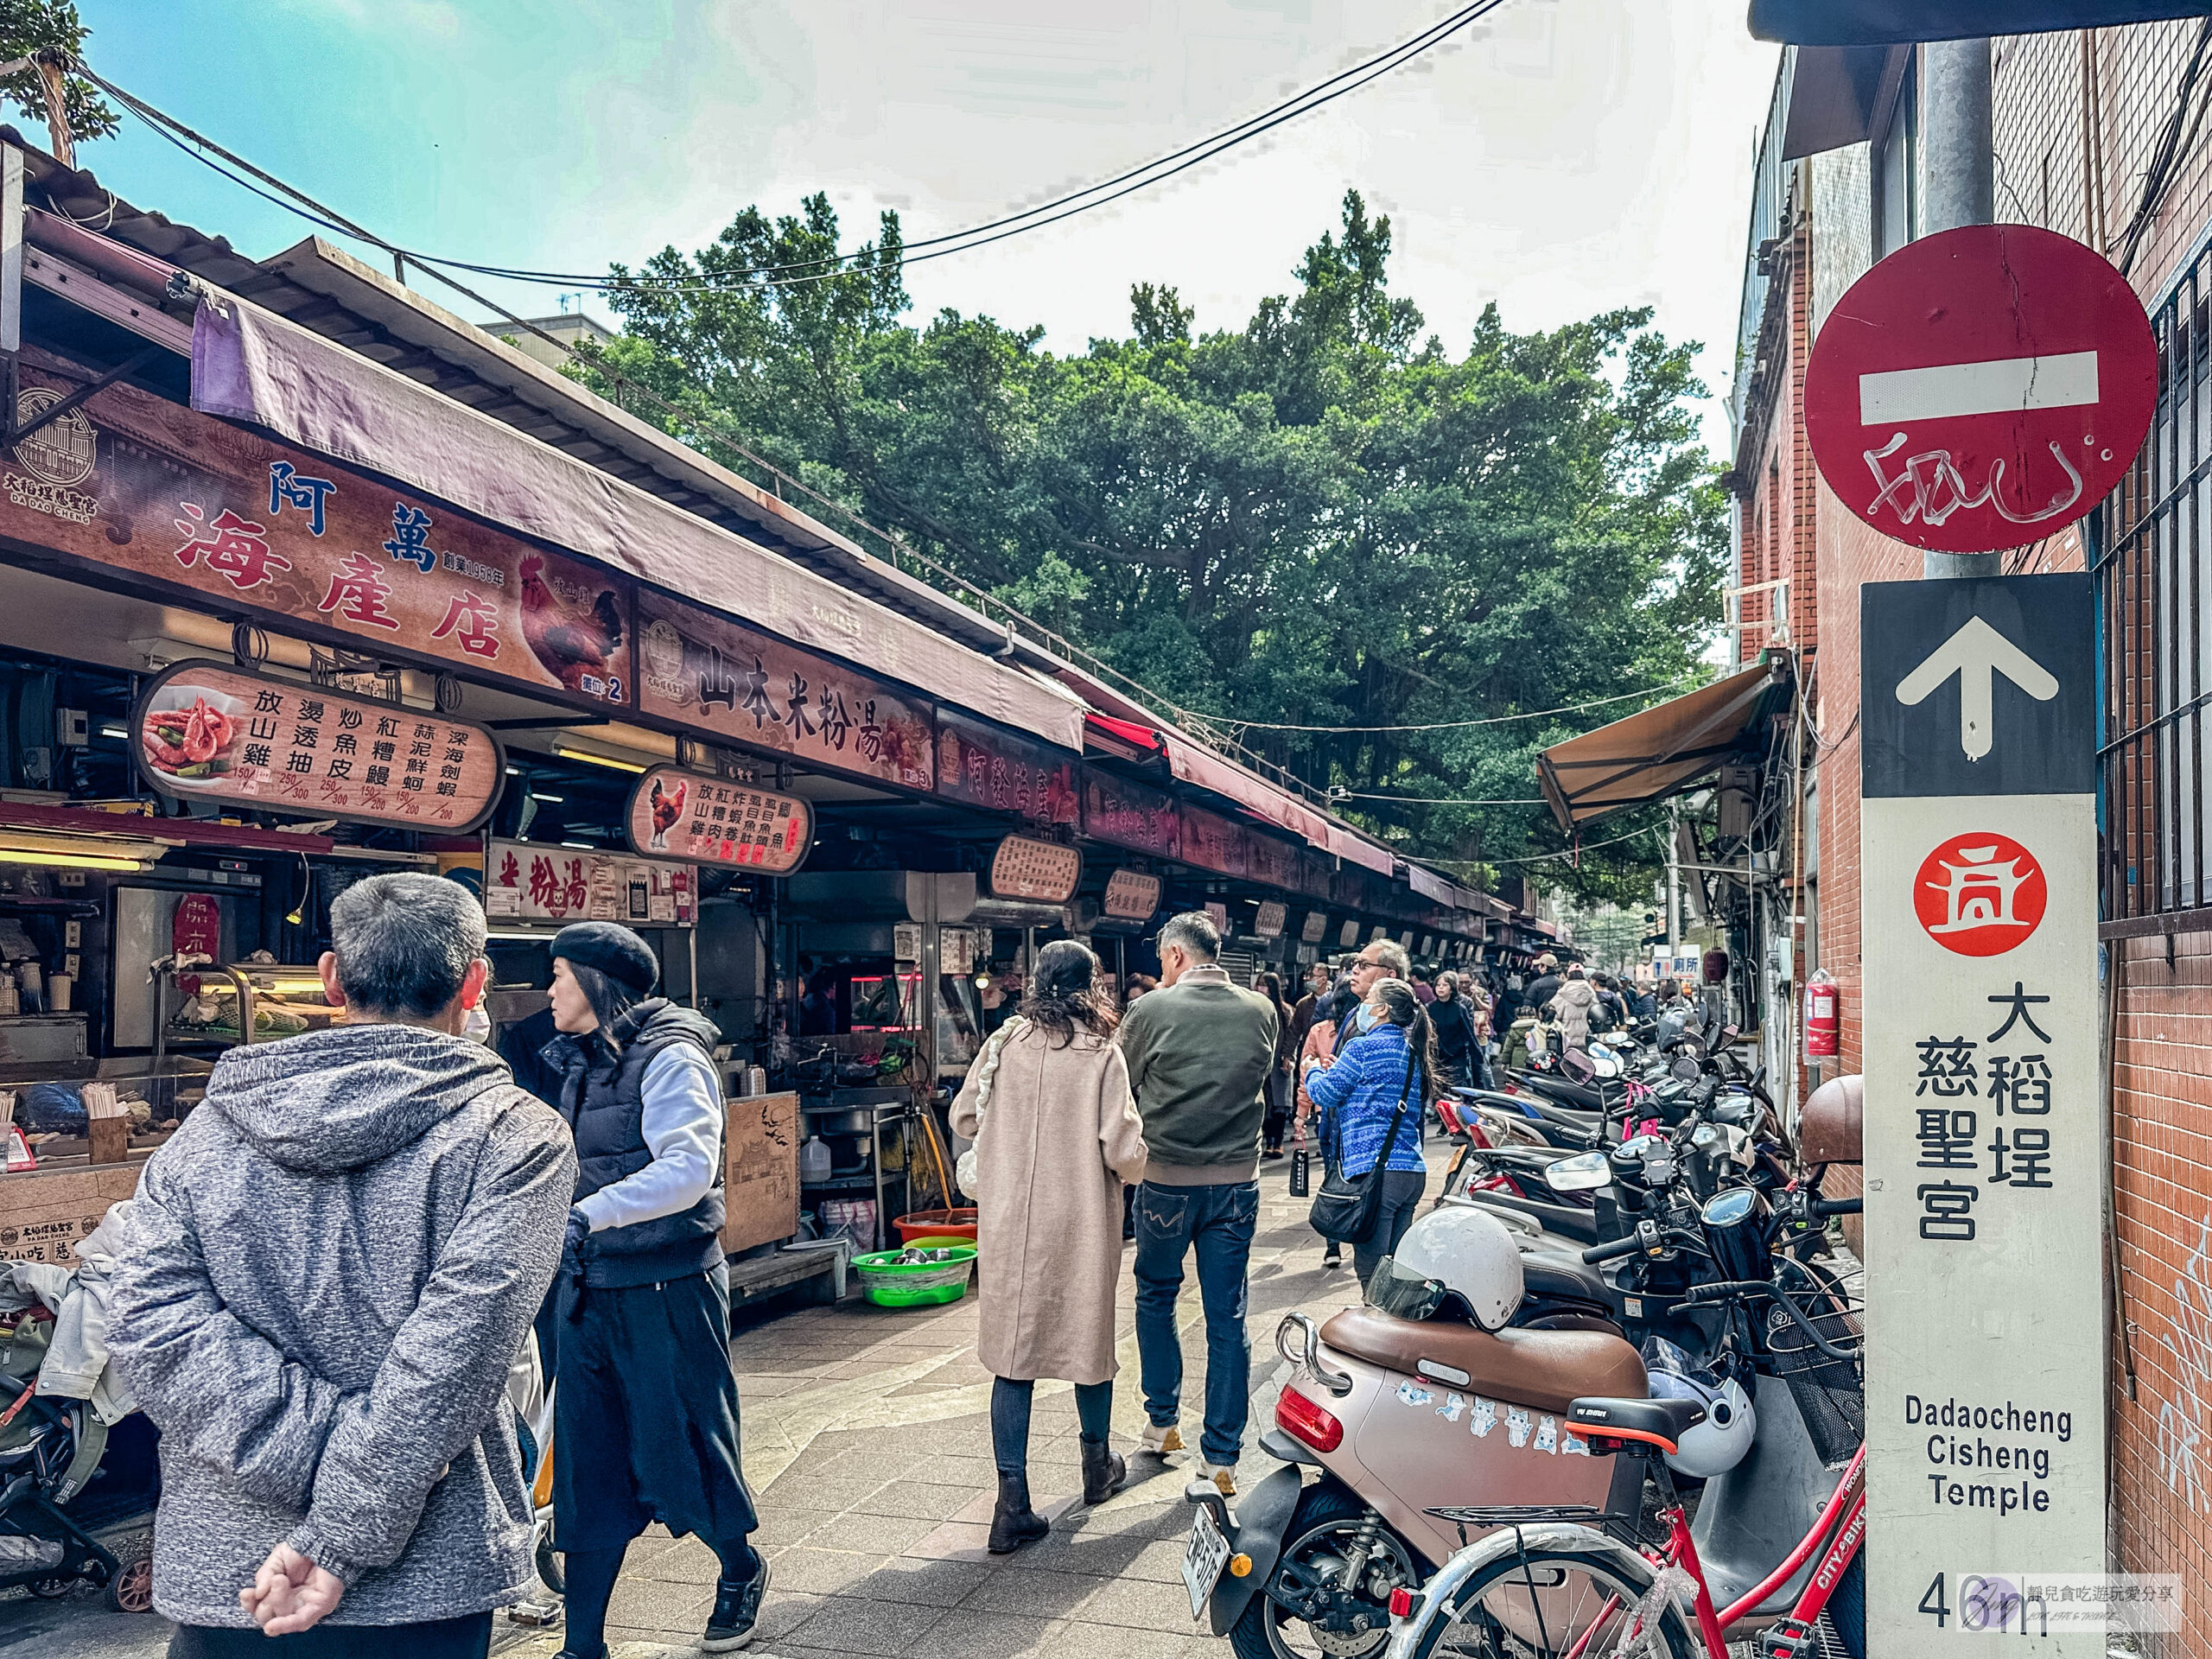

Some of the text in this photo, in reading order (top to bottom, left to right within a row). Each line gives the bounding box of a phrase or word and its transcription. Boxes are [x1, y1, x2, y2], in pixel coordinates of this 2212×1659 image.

[3, 473, 99, 516] 大稻埕慈聖宮
[12, 493, 91, 524] DA DAO CHENG
[269, 461, 436, 573] 阿萬
[174, 501, 501, 659] 海產店
[442, 551, 505, 587] 創業1958年
[607, 677, 622, 702] 2
[698, 643, 882, 763] 山本米粉湯
[242, 690, 283, 767] 放山雞
[286, 698, 324, 773] 燙透抽
[327, 708, 363, 780] 炒魚皮
[365, 715, 401, 787] 紅糟鰻
[402, 723, 436, 791] 蒜泥鮮蚵
[435, 730, 469, 798] 深海劍蝦
[690, 783, 714, 836] 放山雞
[708, 787, 731, 839] 紅糟肉
[1986, 981, 2053, 1188] 大稻埕
[1915, 1035, 1979, 1241] 慈聖宮
[1905, 1395, 2071, 1442] Dadaocheng
[1927, 1433, 2049, 1479] Cisheng
[1928, 1473, 2050, 1517] Temple
[1816, 1550, 1844, 1590] CITY
